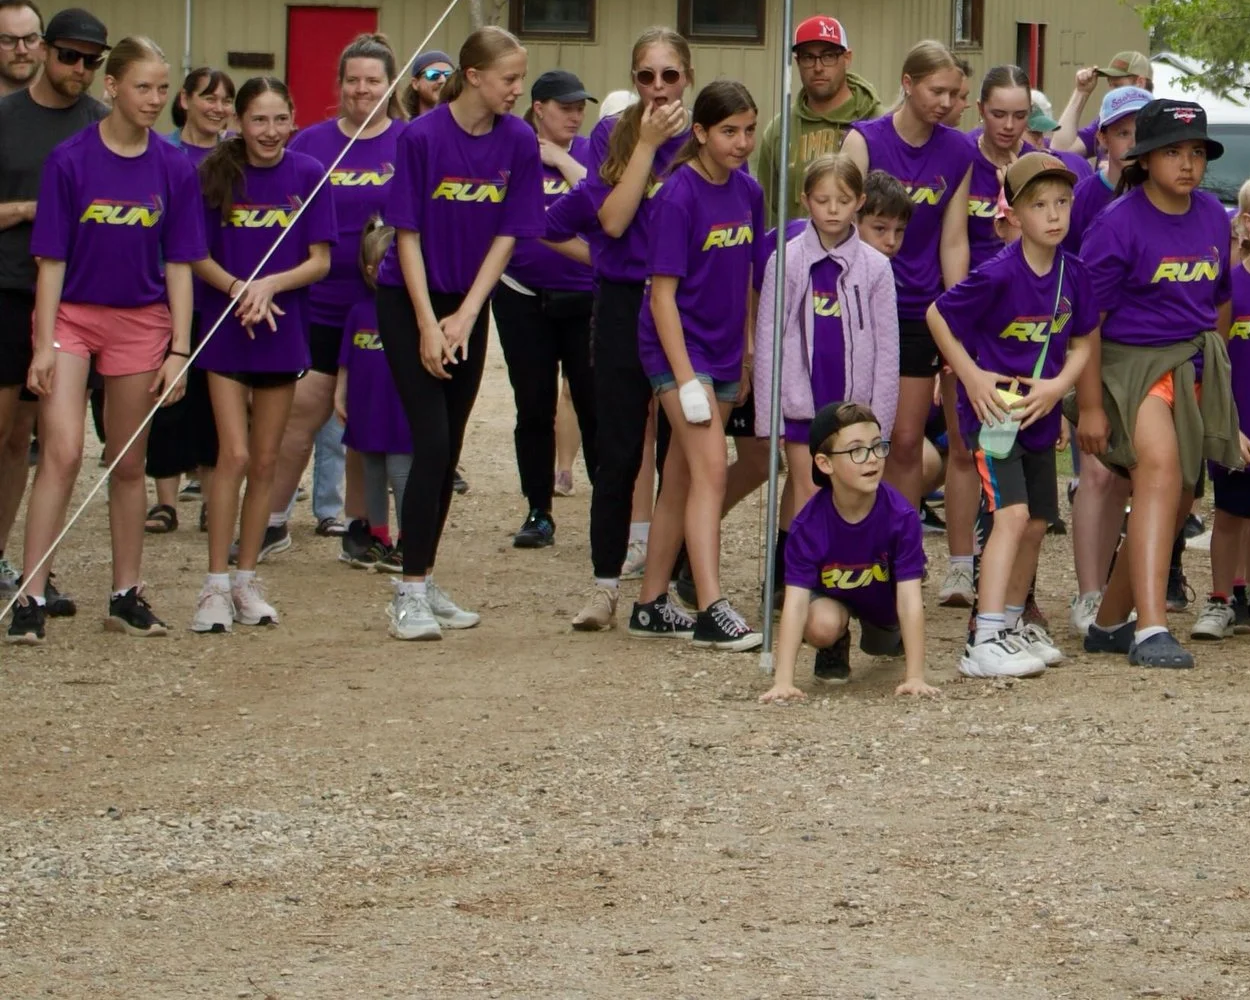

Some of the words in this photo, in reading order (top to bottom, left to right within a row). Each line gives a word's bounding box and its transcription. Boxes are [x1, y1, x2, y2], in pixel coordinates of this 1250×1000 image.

[432, 182, 508, 203] RUN
[80, 204, 163, 227] RUN
[226, 208, 299, 228] RUN
[967, 200, 999, 218] RU
[702, 226, 753, 251] RUN
[1150, 262, 1220, 283] RUN
[353, 333, 384, 350] RU
[821, 564, 889, 590] RUN
